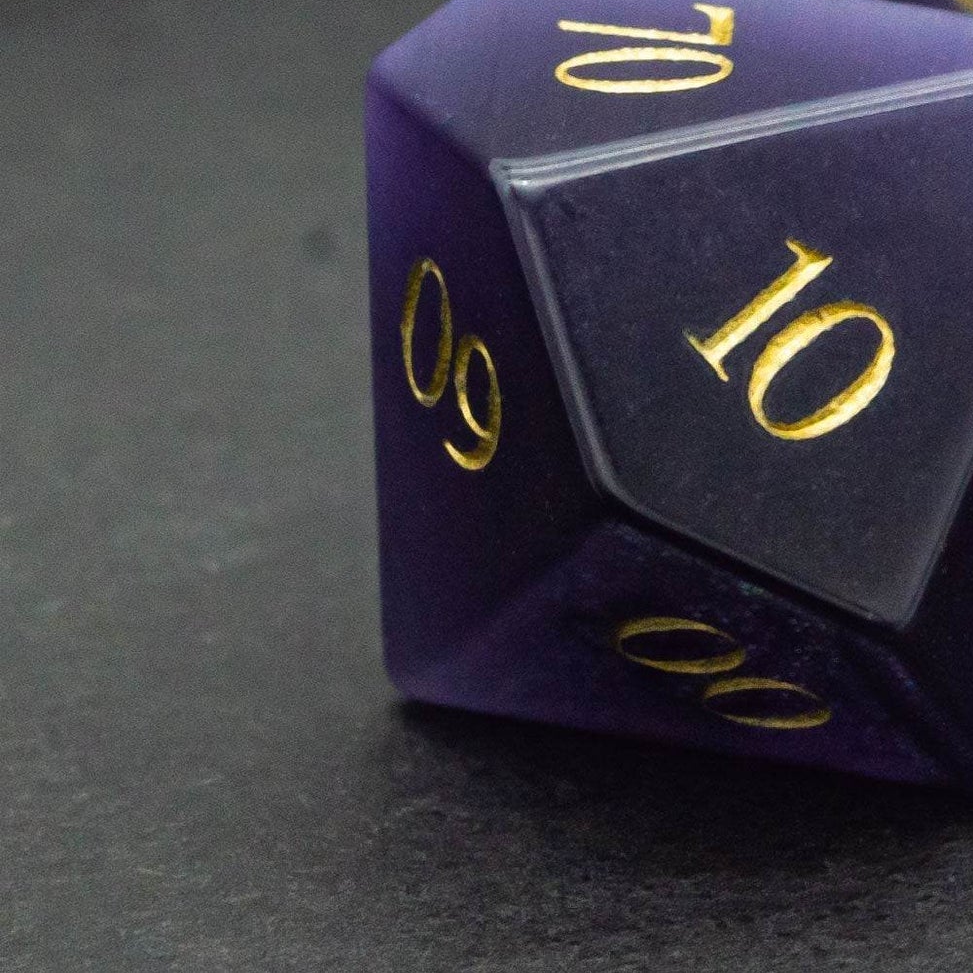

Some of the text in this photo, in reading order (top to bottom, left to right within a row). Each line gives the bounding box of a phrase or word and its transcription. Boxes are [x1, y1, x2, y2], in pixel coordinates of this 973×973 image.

[555, 2, 735, 94] 70
[685, 238, 897, 441] 10
[614, 616, 831, 730] 00
